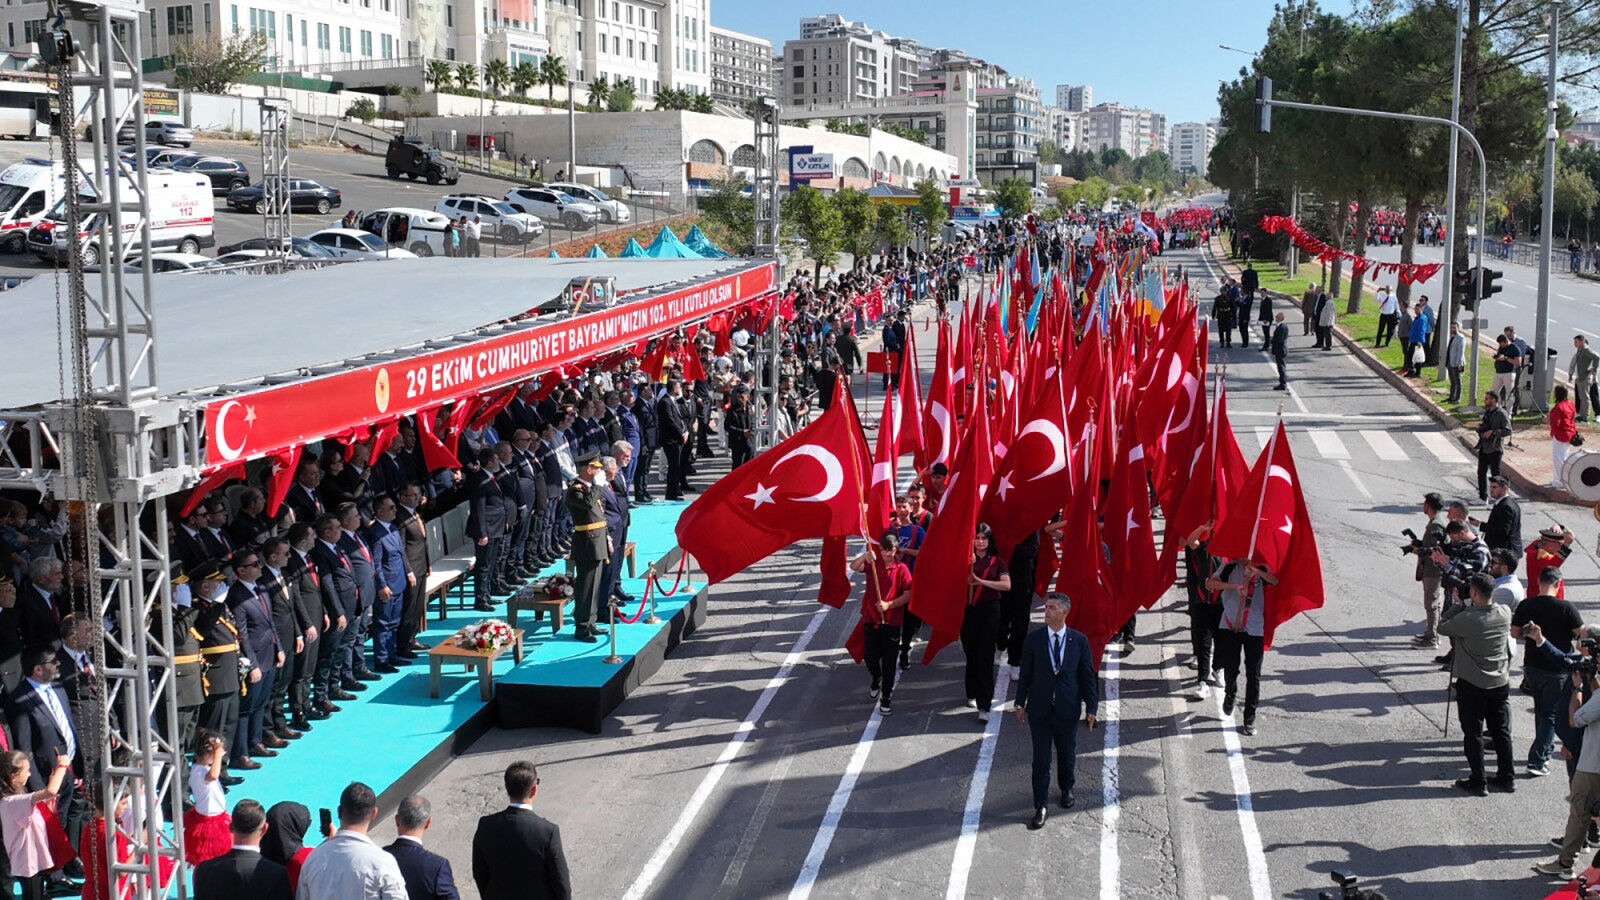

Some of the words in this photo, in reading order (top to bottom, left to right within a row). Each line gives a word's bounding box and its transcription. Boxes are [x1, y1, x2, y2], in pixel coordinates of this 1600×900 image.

[180, 207, 193, 216] 112
[406, 367, 427, 398] 29
[569, 313, 648, 352] BAYRAMI'MIZIN
[650, 303, 667, 325] 102.
[668, 297, 683, 320] YILI
[684, 290, 708, 313] KUTLU
[709, 283, 732, 305] OLSUN
